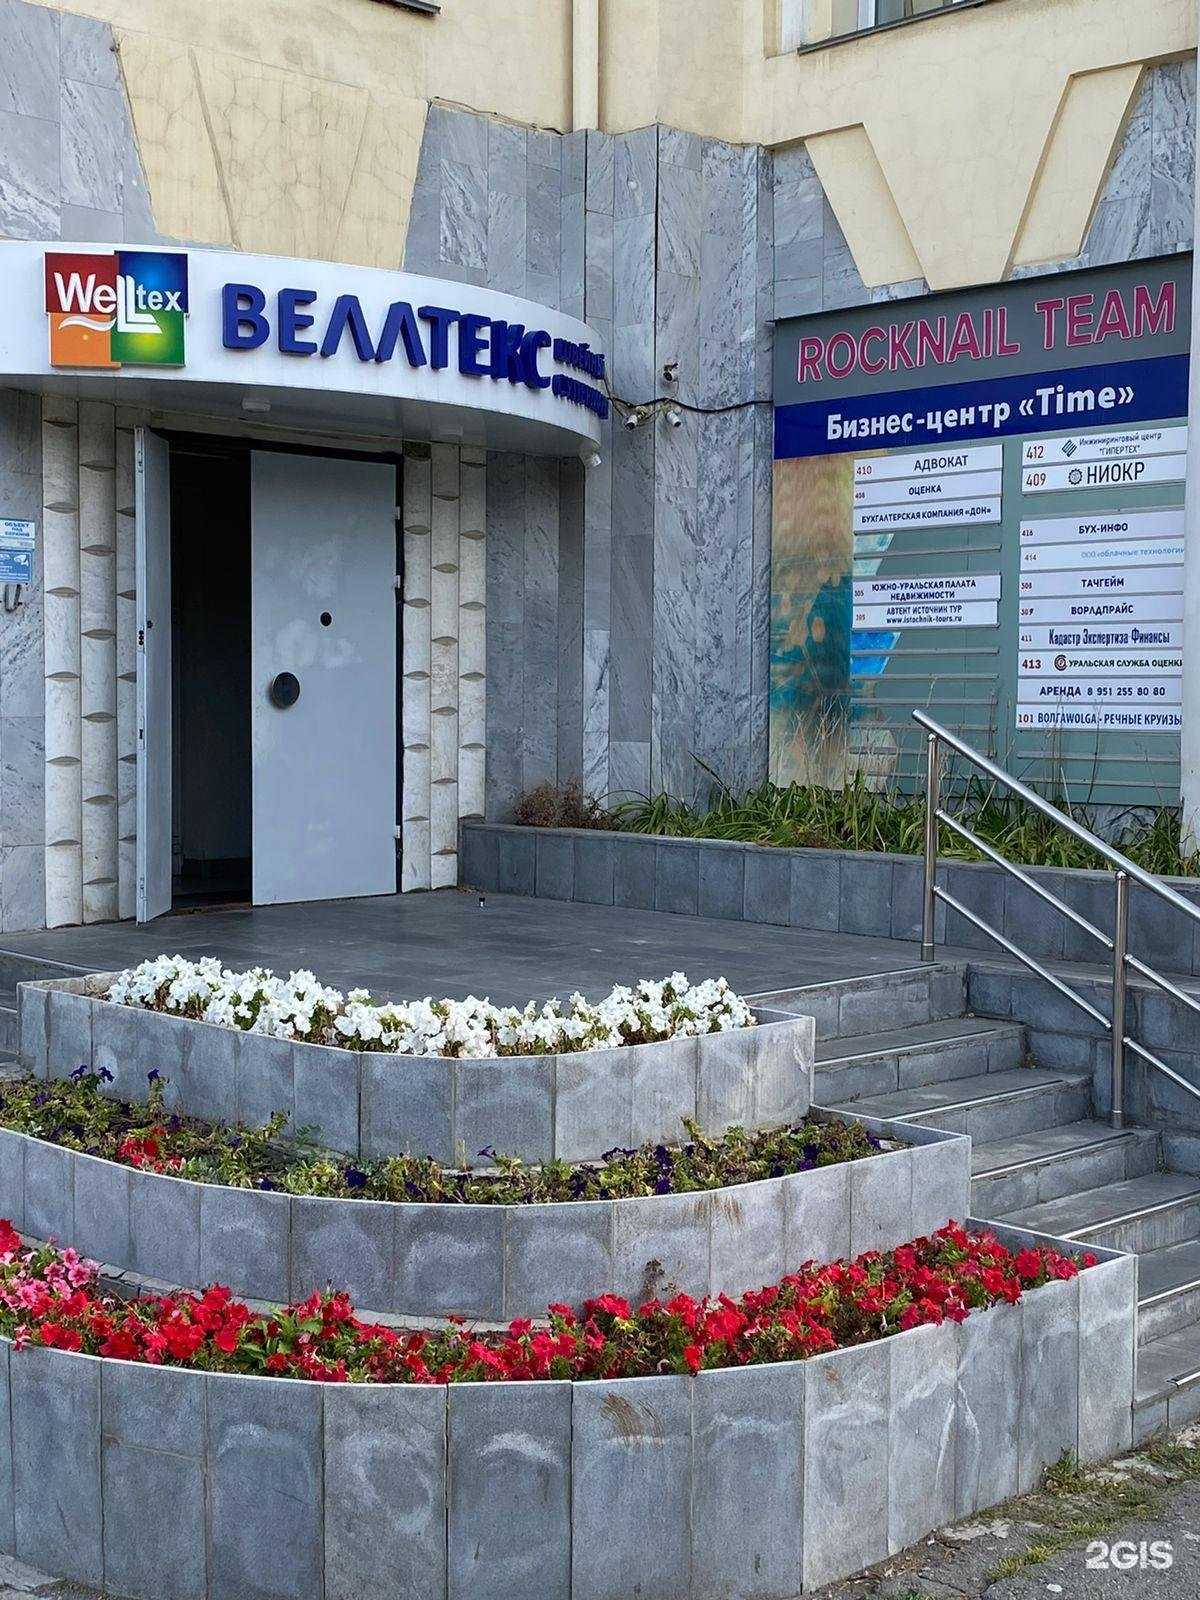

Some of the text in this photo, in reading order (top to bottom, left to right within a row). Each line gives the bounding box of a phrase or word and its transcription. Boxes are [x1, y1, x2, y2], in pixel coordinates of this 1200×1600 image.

[221, 282, 552, 390] ВЕЛЛТЕКС
[797, 281, 1176, 383] ROCKNAIL TEAM
[826, 382, 1135, 440] Бизнес-центр «Time»
[1026, 431, 1162, 459] 412 Инжиниринговый центр
[856, 454, 969, 476] 410 АДВОКАТ
[1026, 461, 1145, 487] 409 НИОКР
[908, 484, 942, 496] ОЦЕНКА
[861, 506, 992, 524] БУХГАЛТЕРСКАЯ КОМПАНИЯ «ДОН»
[1078, 522, 1129, 535] БУХ-ИНФО
[871, 580, 944, 592] ЮЖНО-УРАЛЬСКАЯ
[945, 579, 976, 588] ПАЛАТА
[1081, 575, 1125, 588] ТАЧГЕЙМ
[890, 590, 956, 602] НЕДВИЖИМОСТИ
[912, 605, 948, 615] ИСТОЧНИК
[949, 604, 963, 613] ТУР
[1071, 603, 1134, 616] ВОРЛДПРАЙС
[1049, 629, 1081, 646] Кадастр
[1083, 628, 1129, 646] Экспертиза
[1131, 627, 1170, 644] Финансы
[1022, 659, 1041, 669] 413
[1069, 659, 1115, 668] УРАЛЬСКАЯ
[1117, 659, 1150, 668] СЛУЖБА
[1040, 686, 1166, 697] АРЕНДА 8 951 255 80 80
[1019, 714, 1034, 723] 101
[1104, 713, 1142, 725] РЕЧНЫЕ
